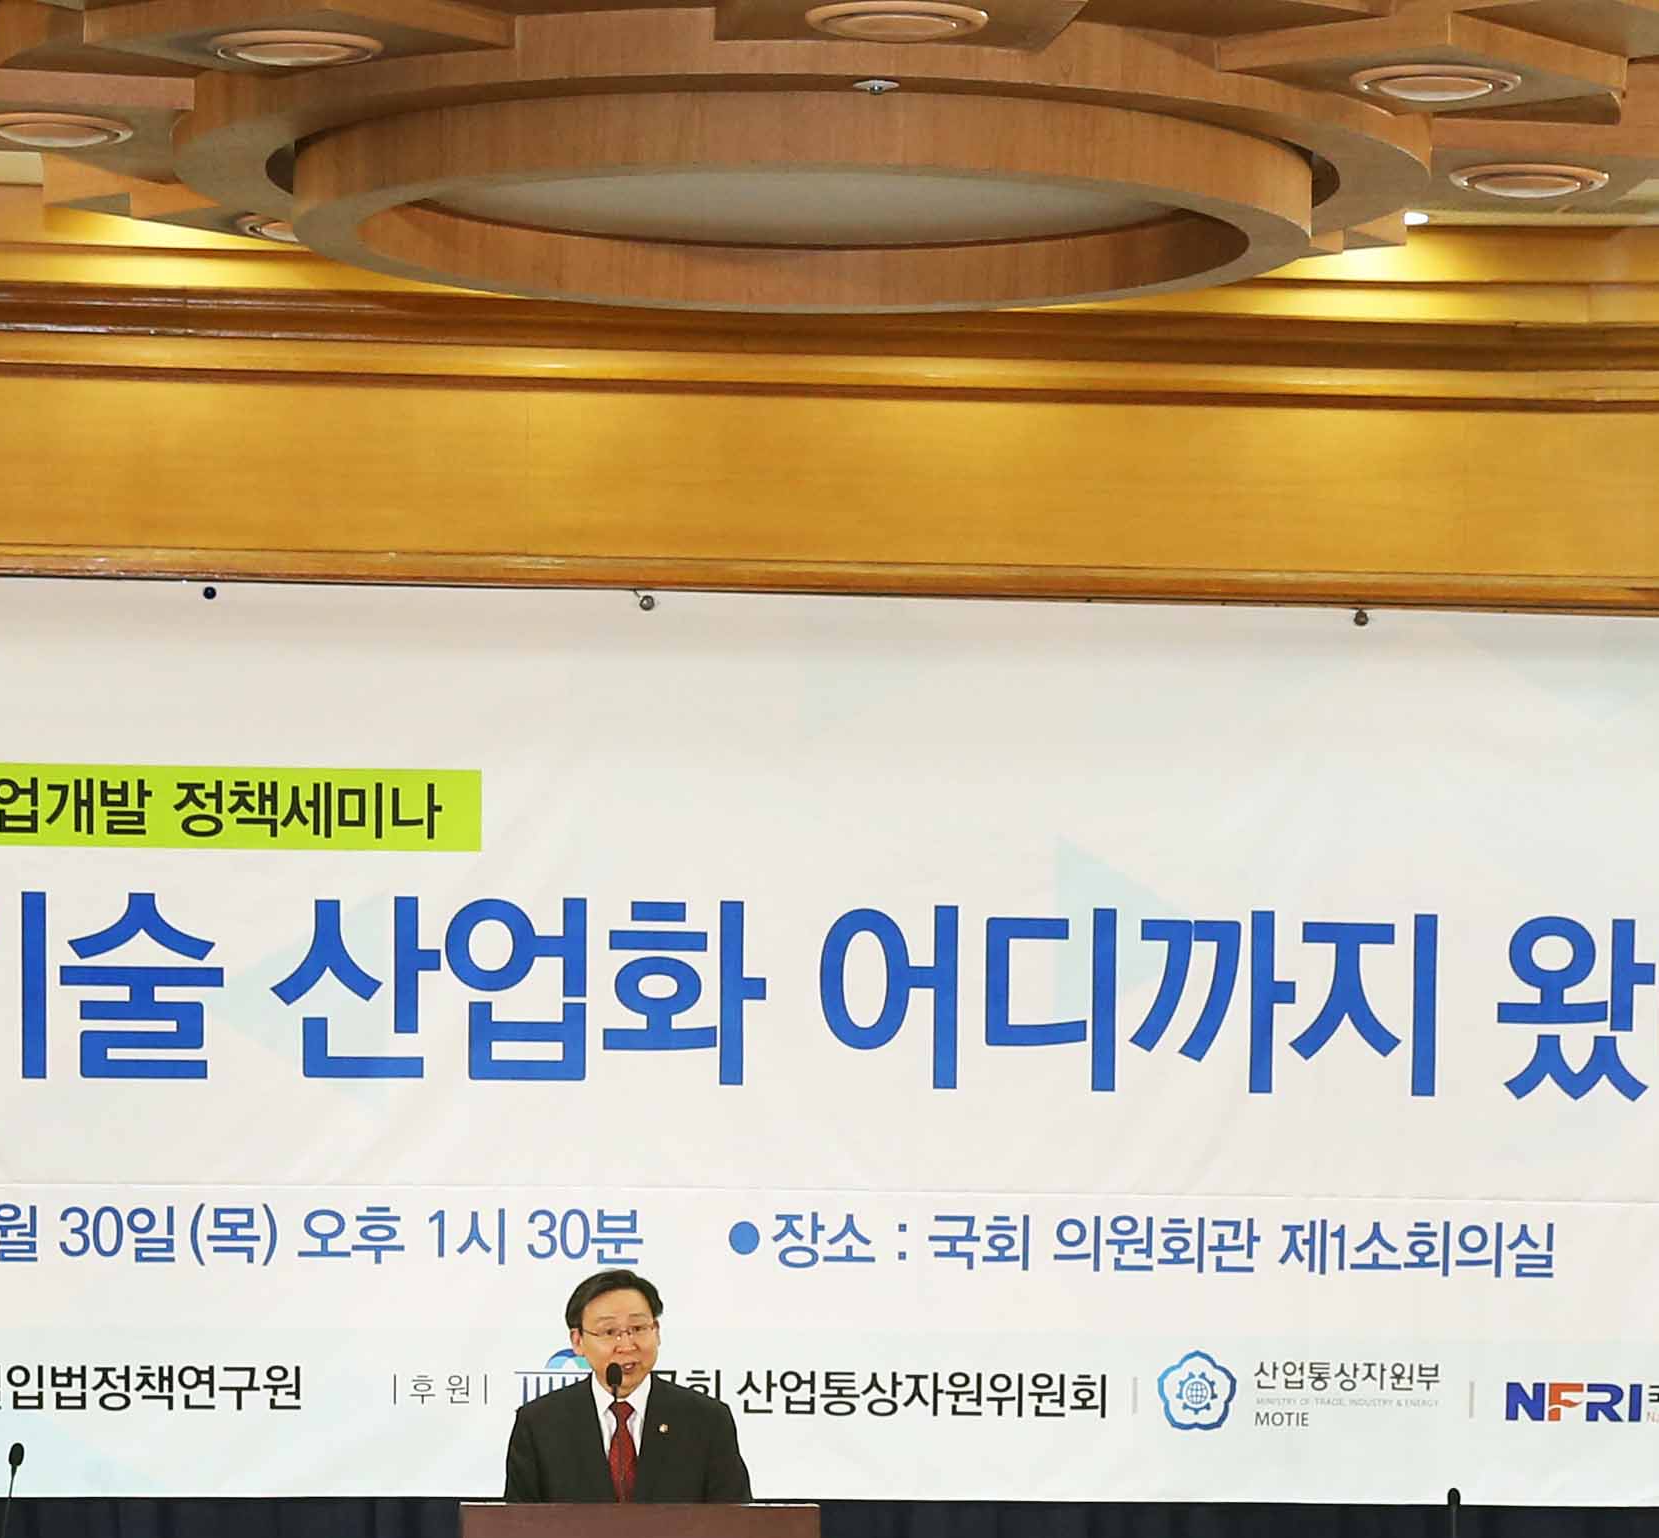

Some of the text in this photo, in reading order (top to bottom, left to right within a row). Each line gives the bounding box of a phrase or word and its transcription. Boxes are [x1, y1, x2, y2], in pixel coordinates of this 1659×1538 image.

[174, 780, 442, 839] 정책세미나
[269, 896, 766, 1086] 산업화
[820, 905, 1438, 1097] 어디까지
[298, 1207, 405, 1264] 오후
[429, 1208, 505, 1265] 1시
[528, 1209, 643, 1264] 30분
[772, 1212, 875, 1268] 장소
[928, 1215, 1029, 1271] 국회
[1053, 1215, 1261, 1273] 의원회관
[1278, 1219, 1554, 1275] 제1소회의실
[737, 1369, 1107, 1417] 산업통상자원위원회
[1254, 1361, 1440, 1391] 산업통상자원부
[1505, 1382, 1642, 1422] NFRI
[1255, 1412, 1308, 1426] MOTIE
